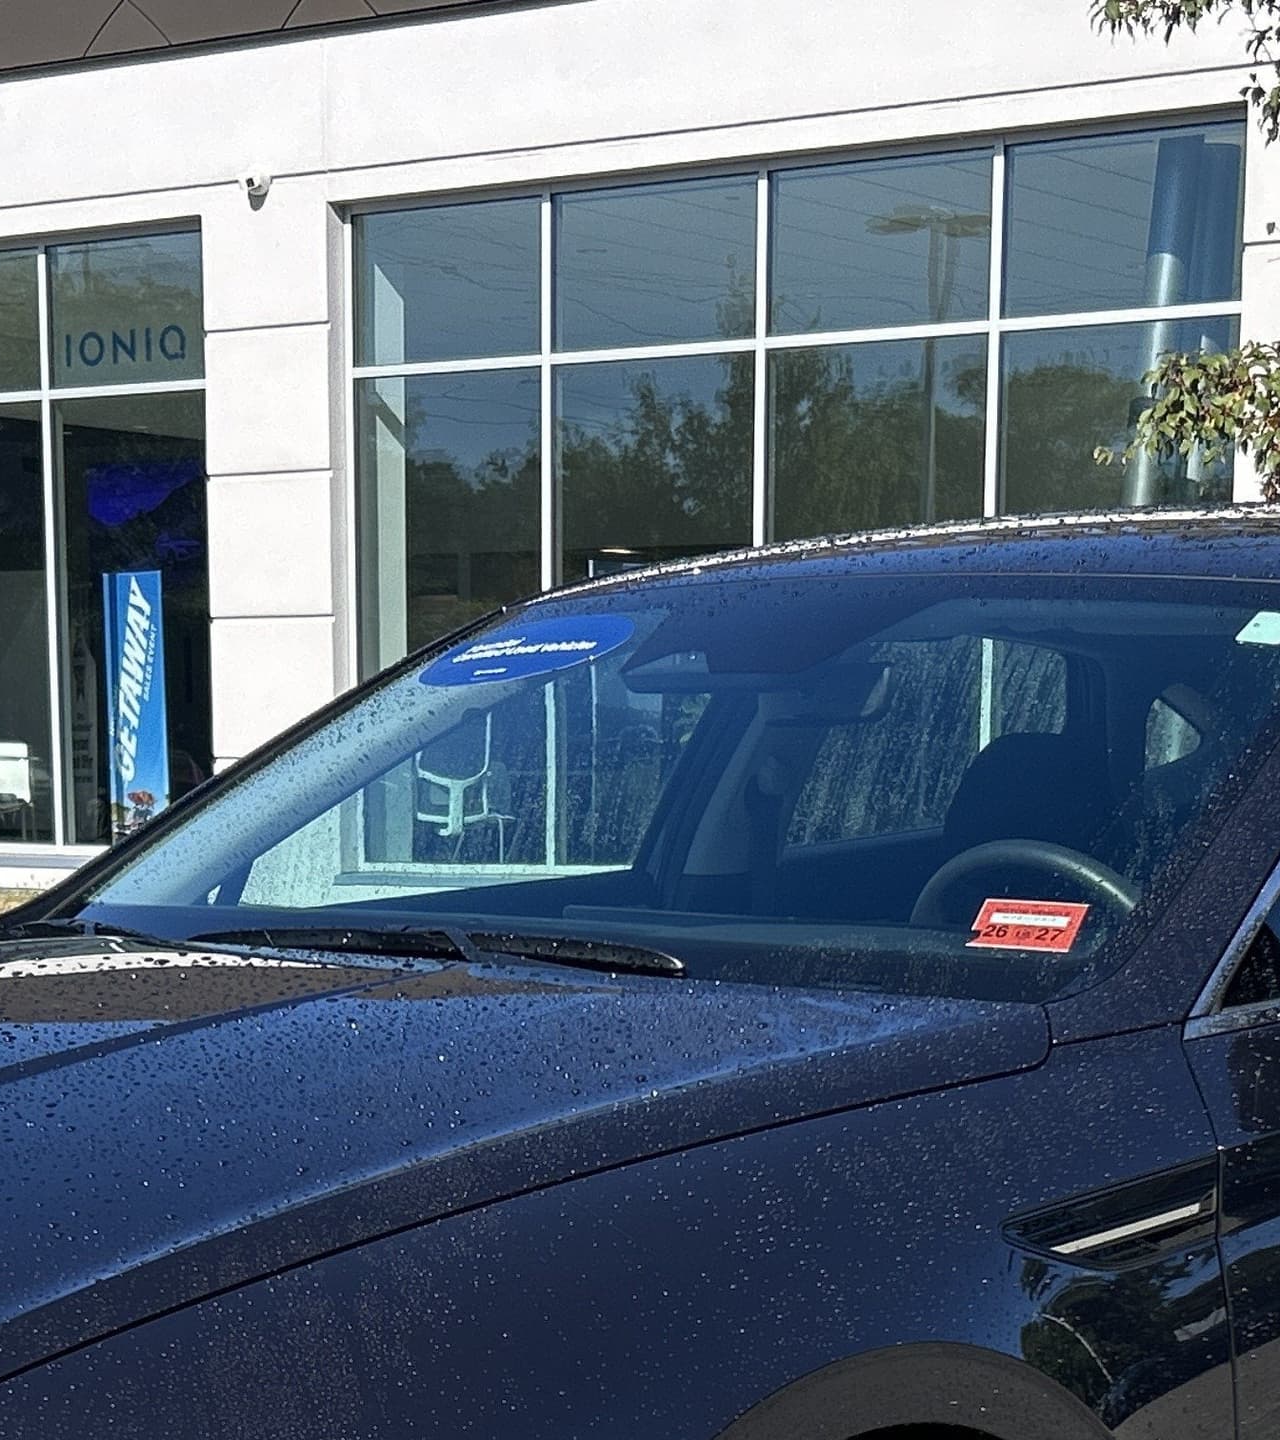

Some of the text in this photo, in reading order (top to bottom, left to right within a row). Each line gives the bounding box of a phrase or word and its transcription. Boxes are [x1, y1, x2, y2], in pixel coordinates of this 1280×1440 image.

[64, 324, 187, 368] IONIQ
[116, 575, 152, 783] GETAWAY
[981, 923, 1010, 939] 26
[1034, 927, 1065, 942] 27
